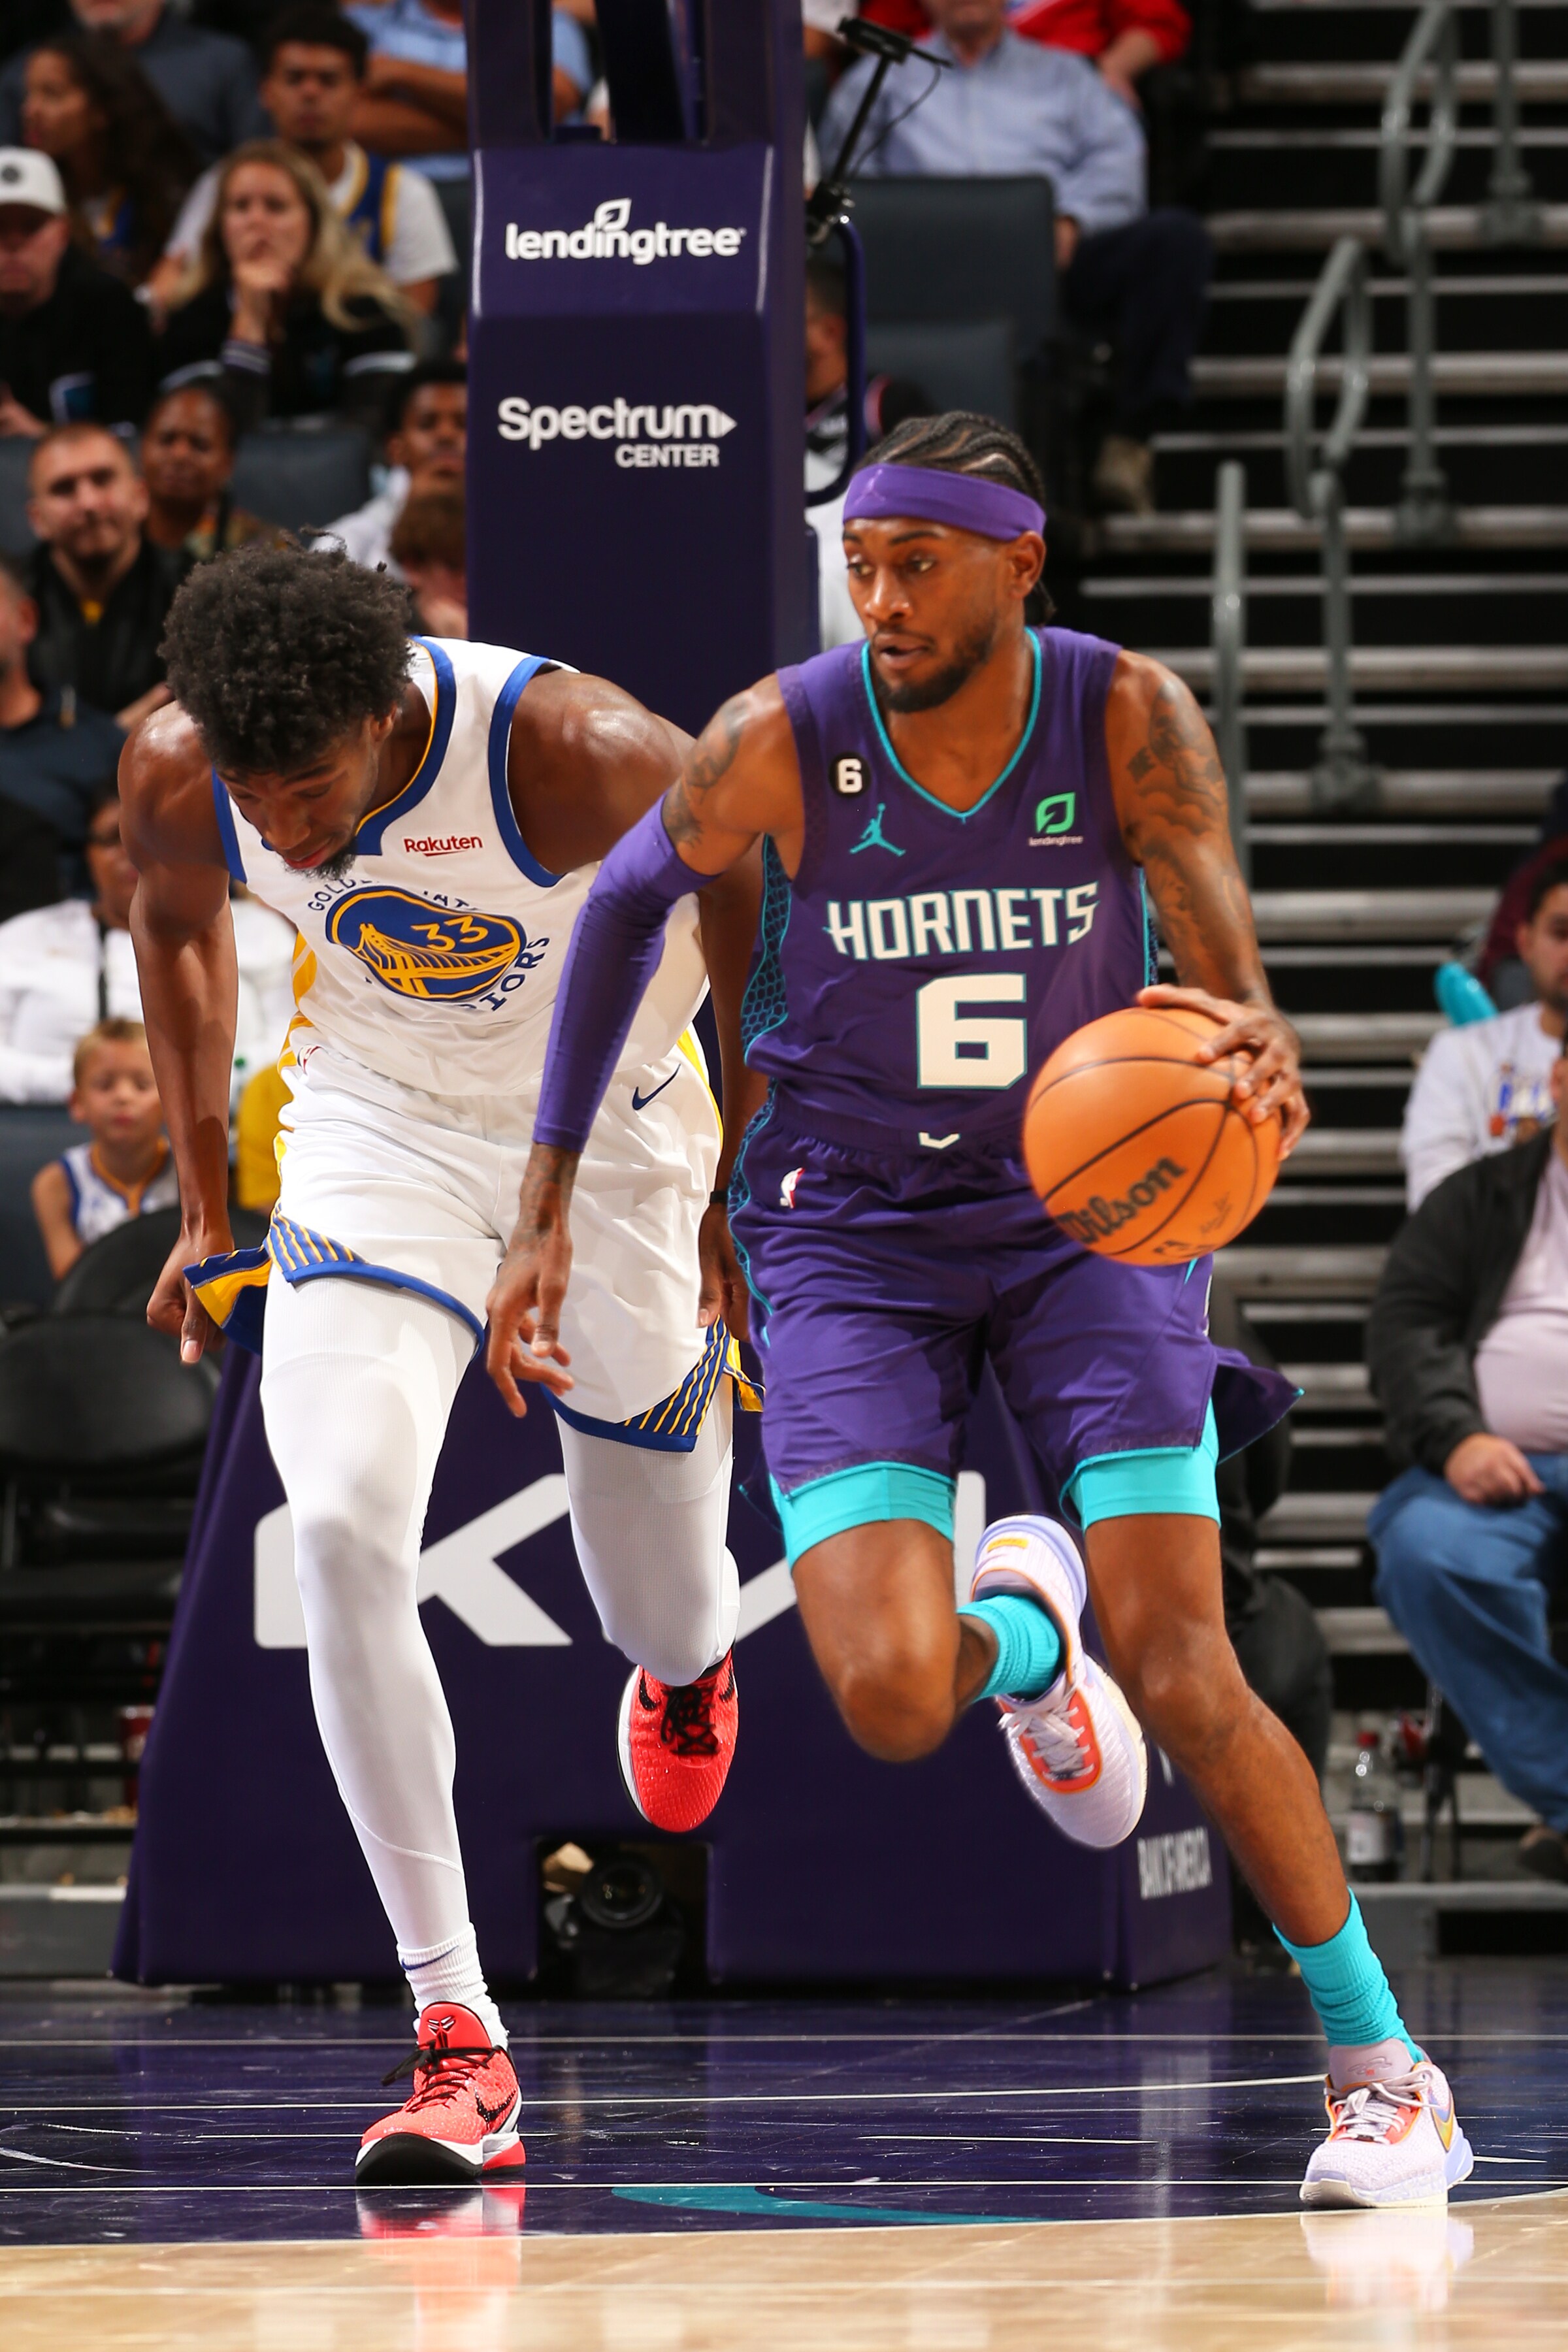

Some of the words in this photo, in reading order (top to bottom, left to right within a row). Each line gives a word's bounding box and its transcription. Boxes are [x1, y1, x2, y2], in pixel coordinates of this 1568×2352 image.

[505, 221, 742, 265] lendingtree
[497, 397, 721, 450] Spectrum
[615, 444, 720, 468] CENTER
[838, 758, 862, 793] 6
[404, 834, 483, 854] Rakuten
[307, 878, 376, 911] GOLD
[410, 916, 489, 952] 33
[822, 881, 1100, 961] HORNETS
[917, 972, 1028, 1090] 6
